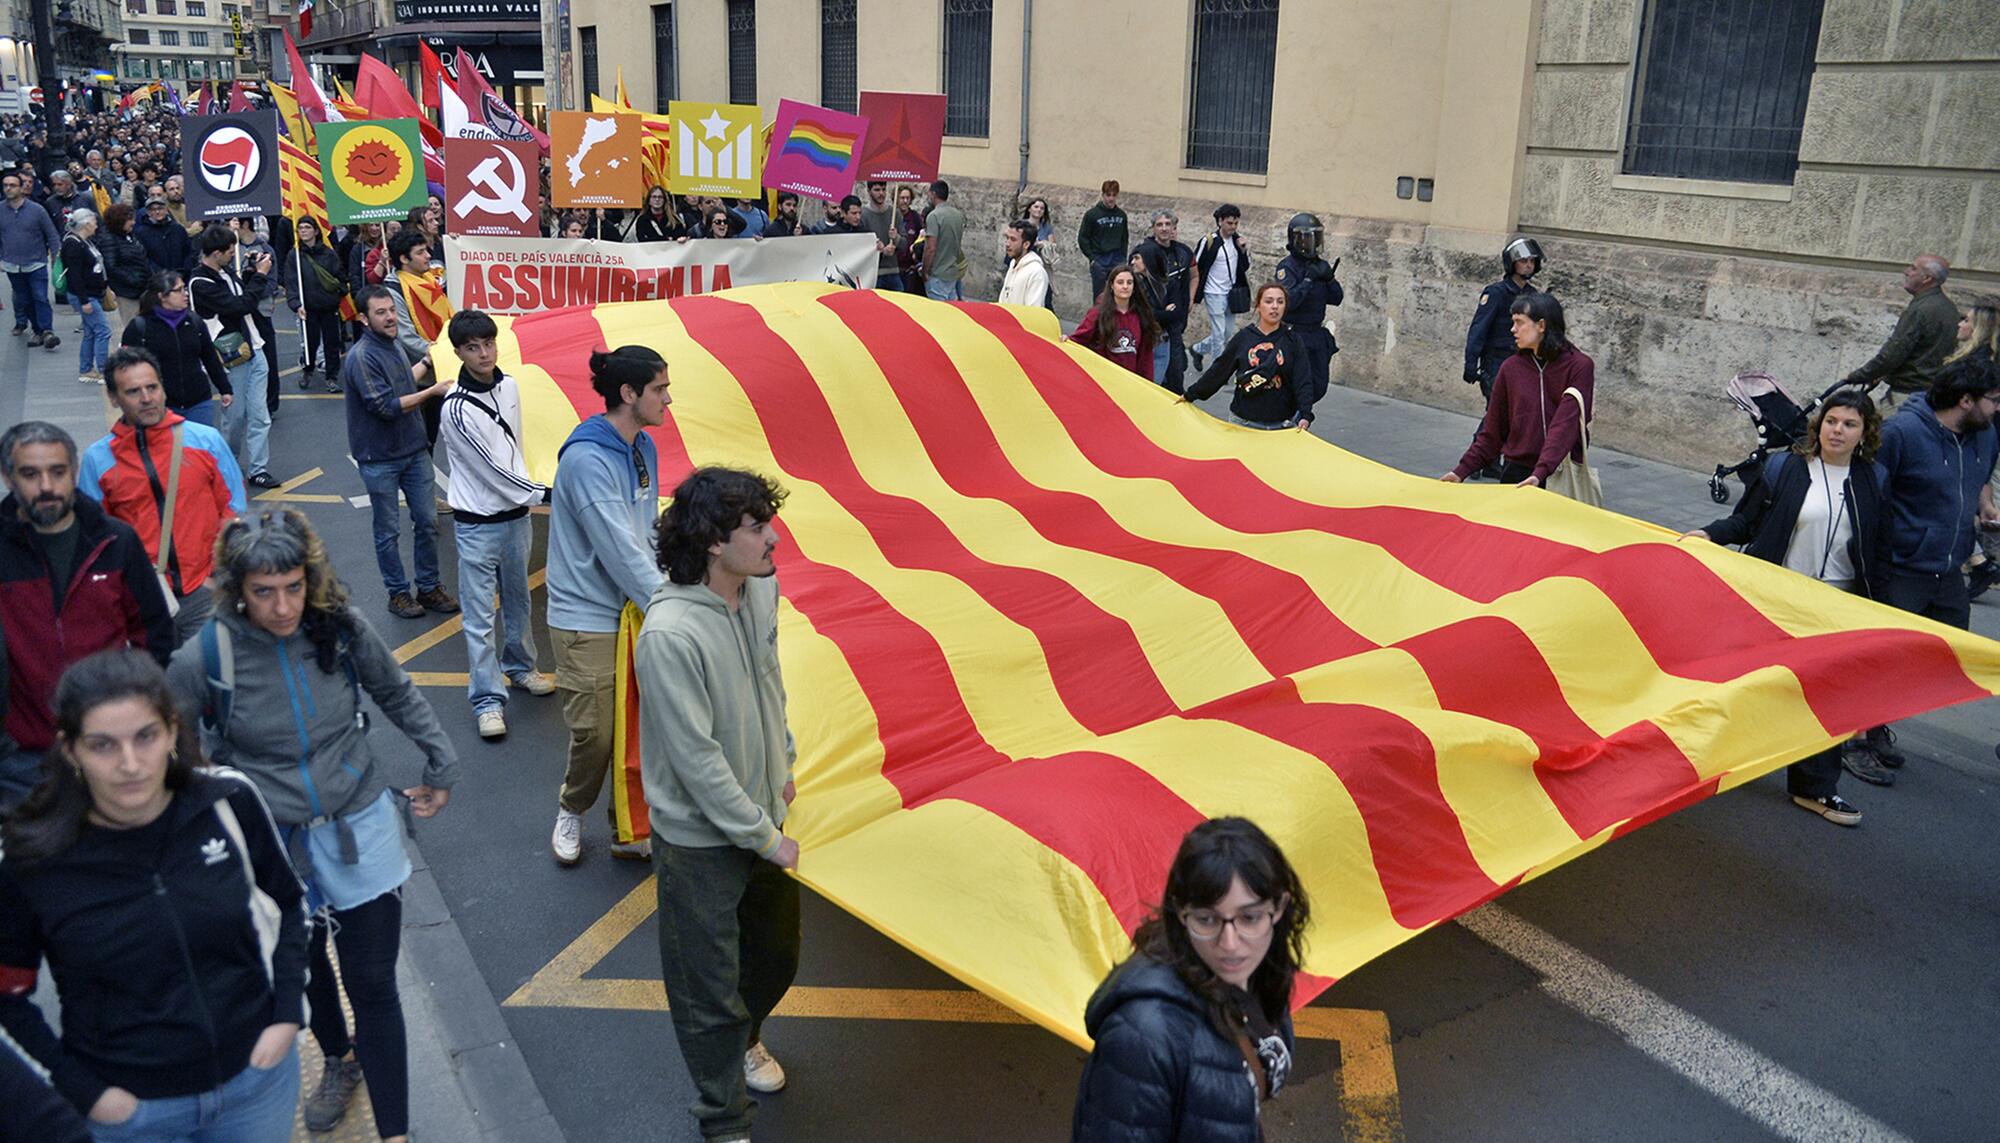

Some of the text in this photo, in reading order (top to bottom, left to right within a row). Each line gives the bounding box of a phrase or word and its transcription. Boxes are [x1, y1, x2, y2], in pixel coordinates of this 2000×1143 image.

[418, 4, 499, 14] INDUMENTARIA
[232, 12, 245, 57] HOTEL
[440, 51, 495, 78] ROA
[460, 250, 625, 265] DIADA DEL PAÍS VALENCIÀ 25A
[463, 264, 685, 310] ASSUMIREM
